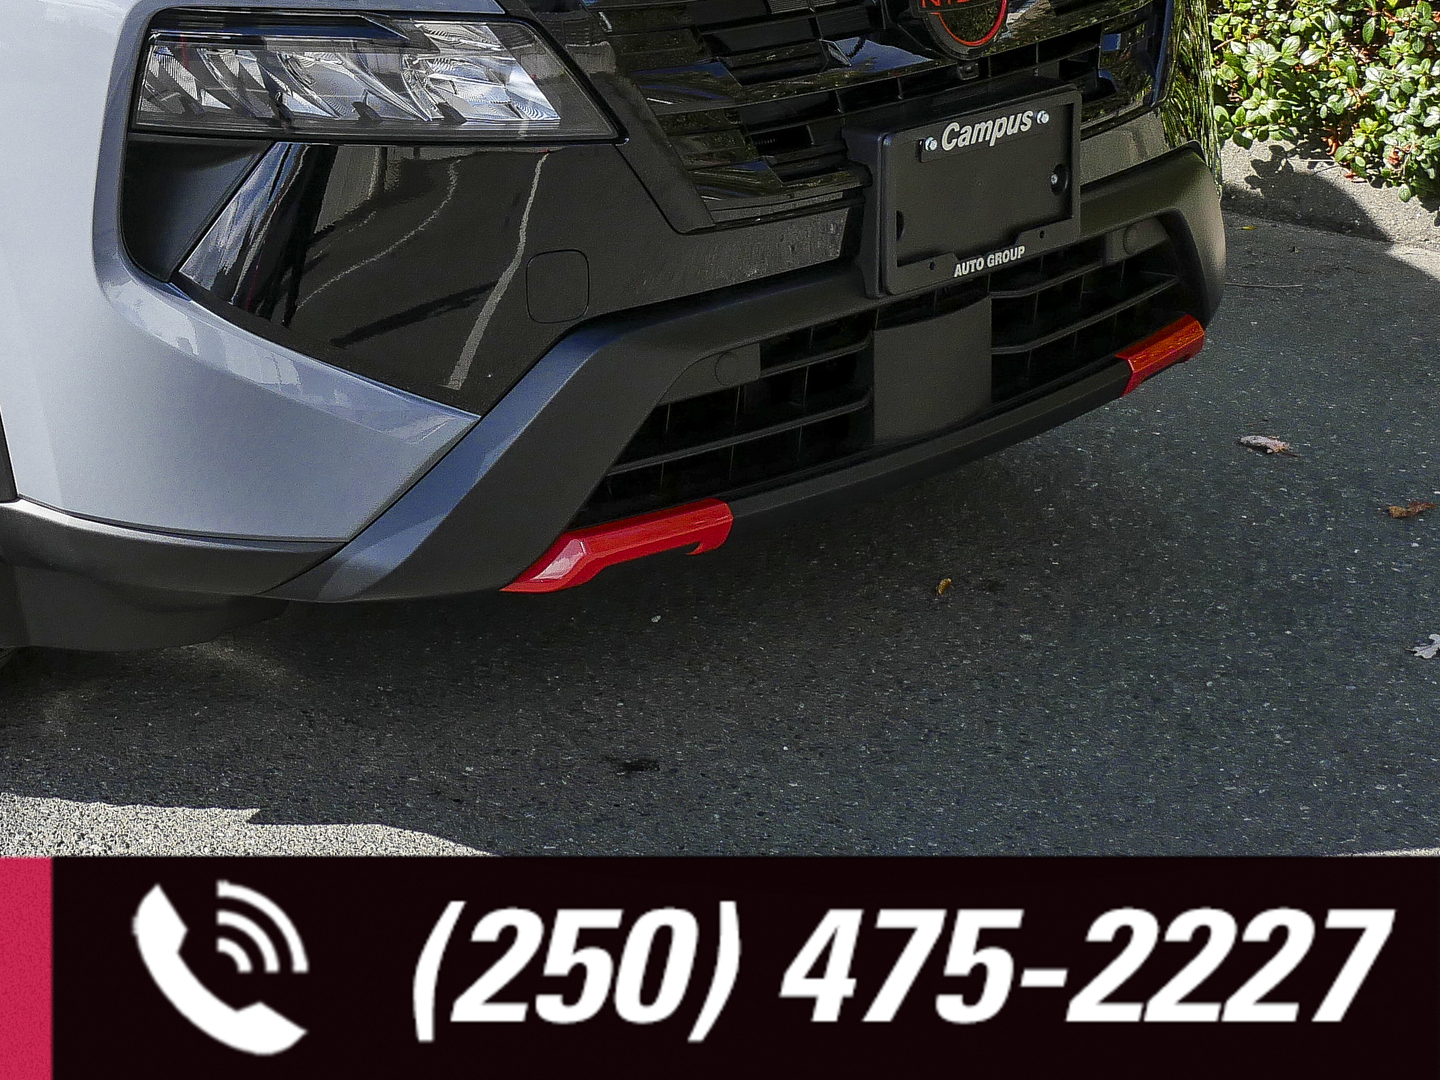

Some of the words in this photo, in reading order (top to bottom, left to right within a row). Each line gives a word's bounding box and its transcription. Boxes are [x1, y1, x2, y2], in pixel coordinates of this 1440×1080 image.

[941, 110, 1034, 151] Campus
[953, 258, 985, 278] AUTO
[986, 245, 1026, 269] GROUP
